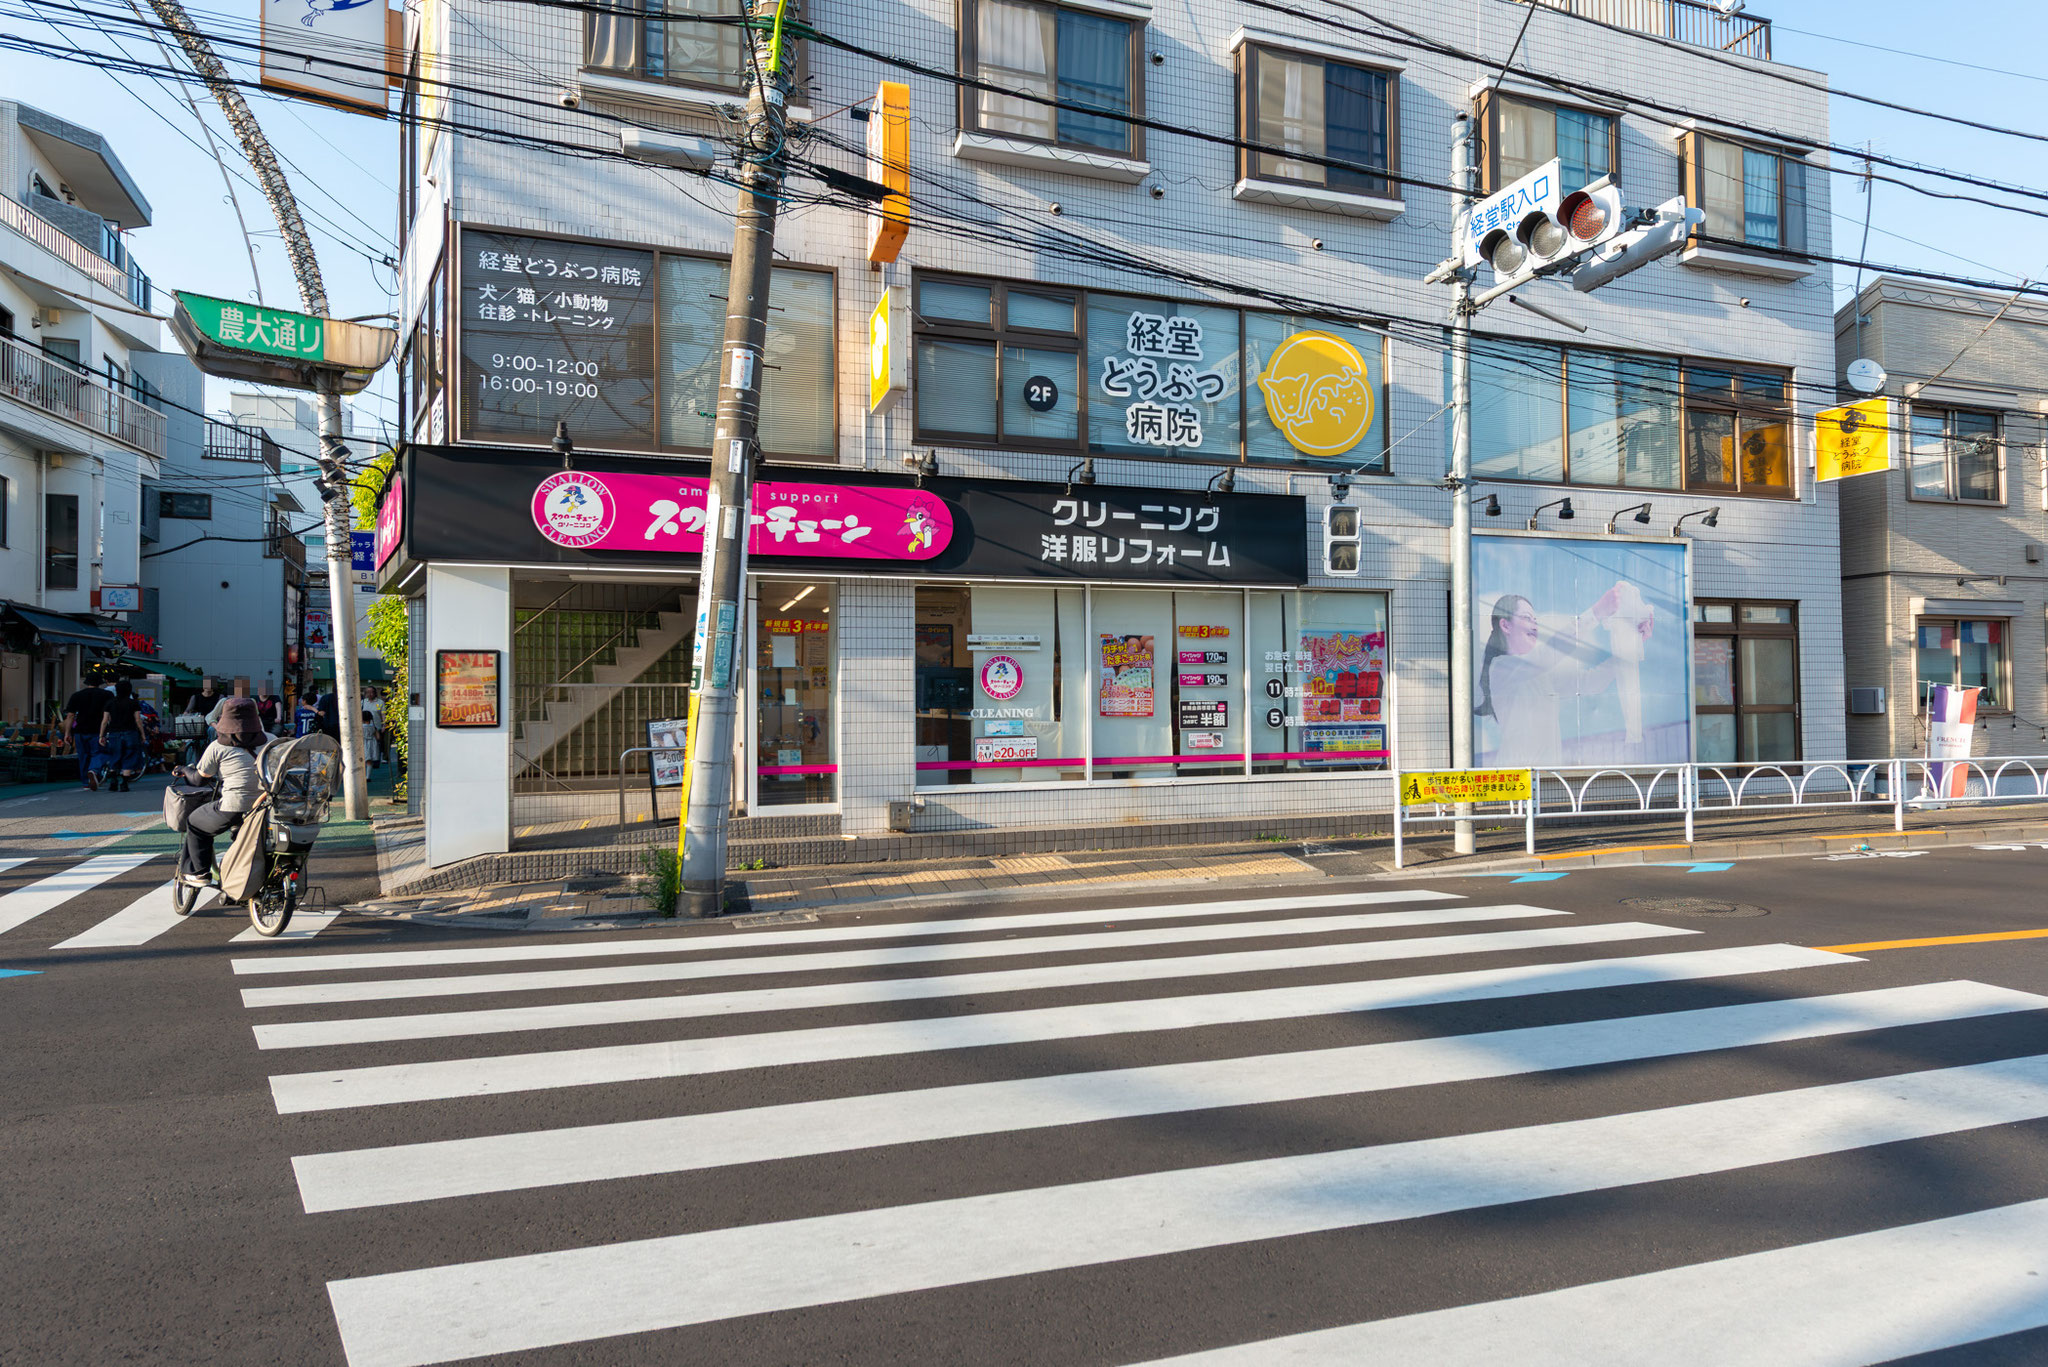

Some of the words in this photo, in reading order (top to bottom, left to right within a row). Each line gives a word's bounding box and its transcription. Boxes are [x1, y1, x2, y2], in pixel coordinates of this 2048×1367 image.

[1470, 175, 1548, 238] 経堂駅入口
[479, 251, 641, 286] 経堂どうぶつ病院
[219, 306, 321, 352] 農大通り
[1130, 314, 1201, 357] 経堂
[492, 353, 598, 376] 9:00-12:00
[480, 374, 598, 398] 16:00-19:00
[1104, 359, 1225, 399] どうぶつ
[1029, 386, 1051, 402] 2F
[1129, 405, 1201, 444] 病院
[1840, 436, 1861, 448] 経堂
[1841, 459, 1862, 471] 病院
[540, 474, 608, 497] SWALLOW
[770, 492, 839, 503] support
[1052, 500, 1220, 533] クリーニング
[541, 523, 608, 547] CLEANING
[1041, 533, 1231, 567] 洋服リフォーム
[1269, 683, 1280, 694] 11
[1334, 672, 1383, 698] 半額
[970, 708, 1034, 718] CLEANING
[1200, 712, 1225, 726] 半額
[1270, 712, 1280, 724] 5
[1424, 783, 1525, 795] 自転車から降りて歩きましょう
[1427, 774, 1520, 785] 歩行者が多い横断歩道では
